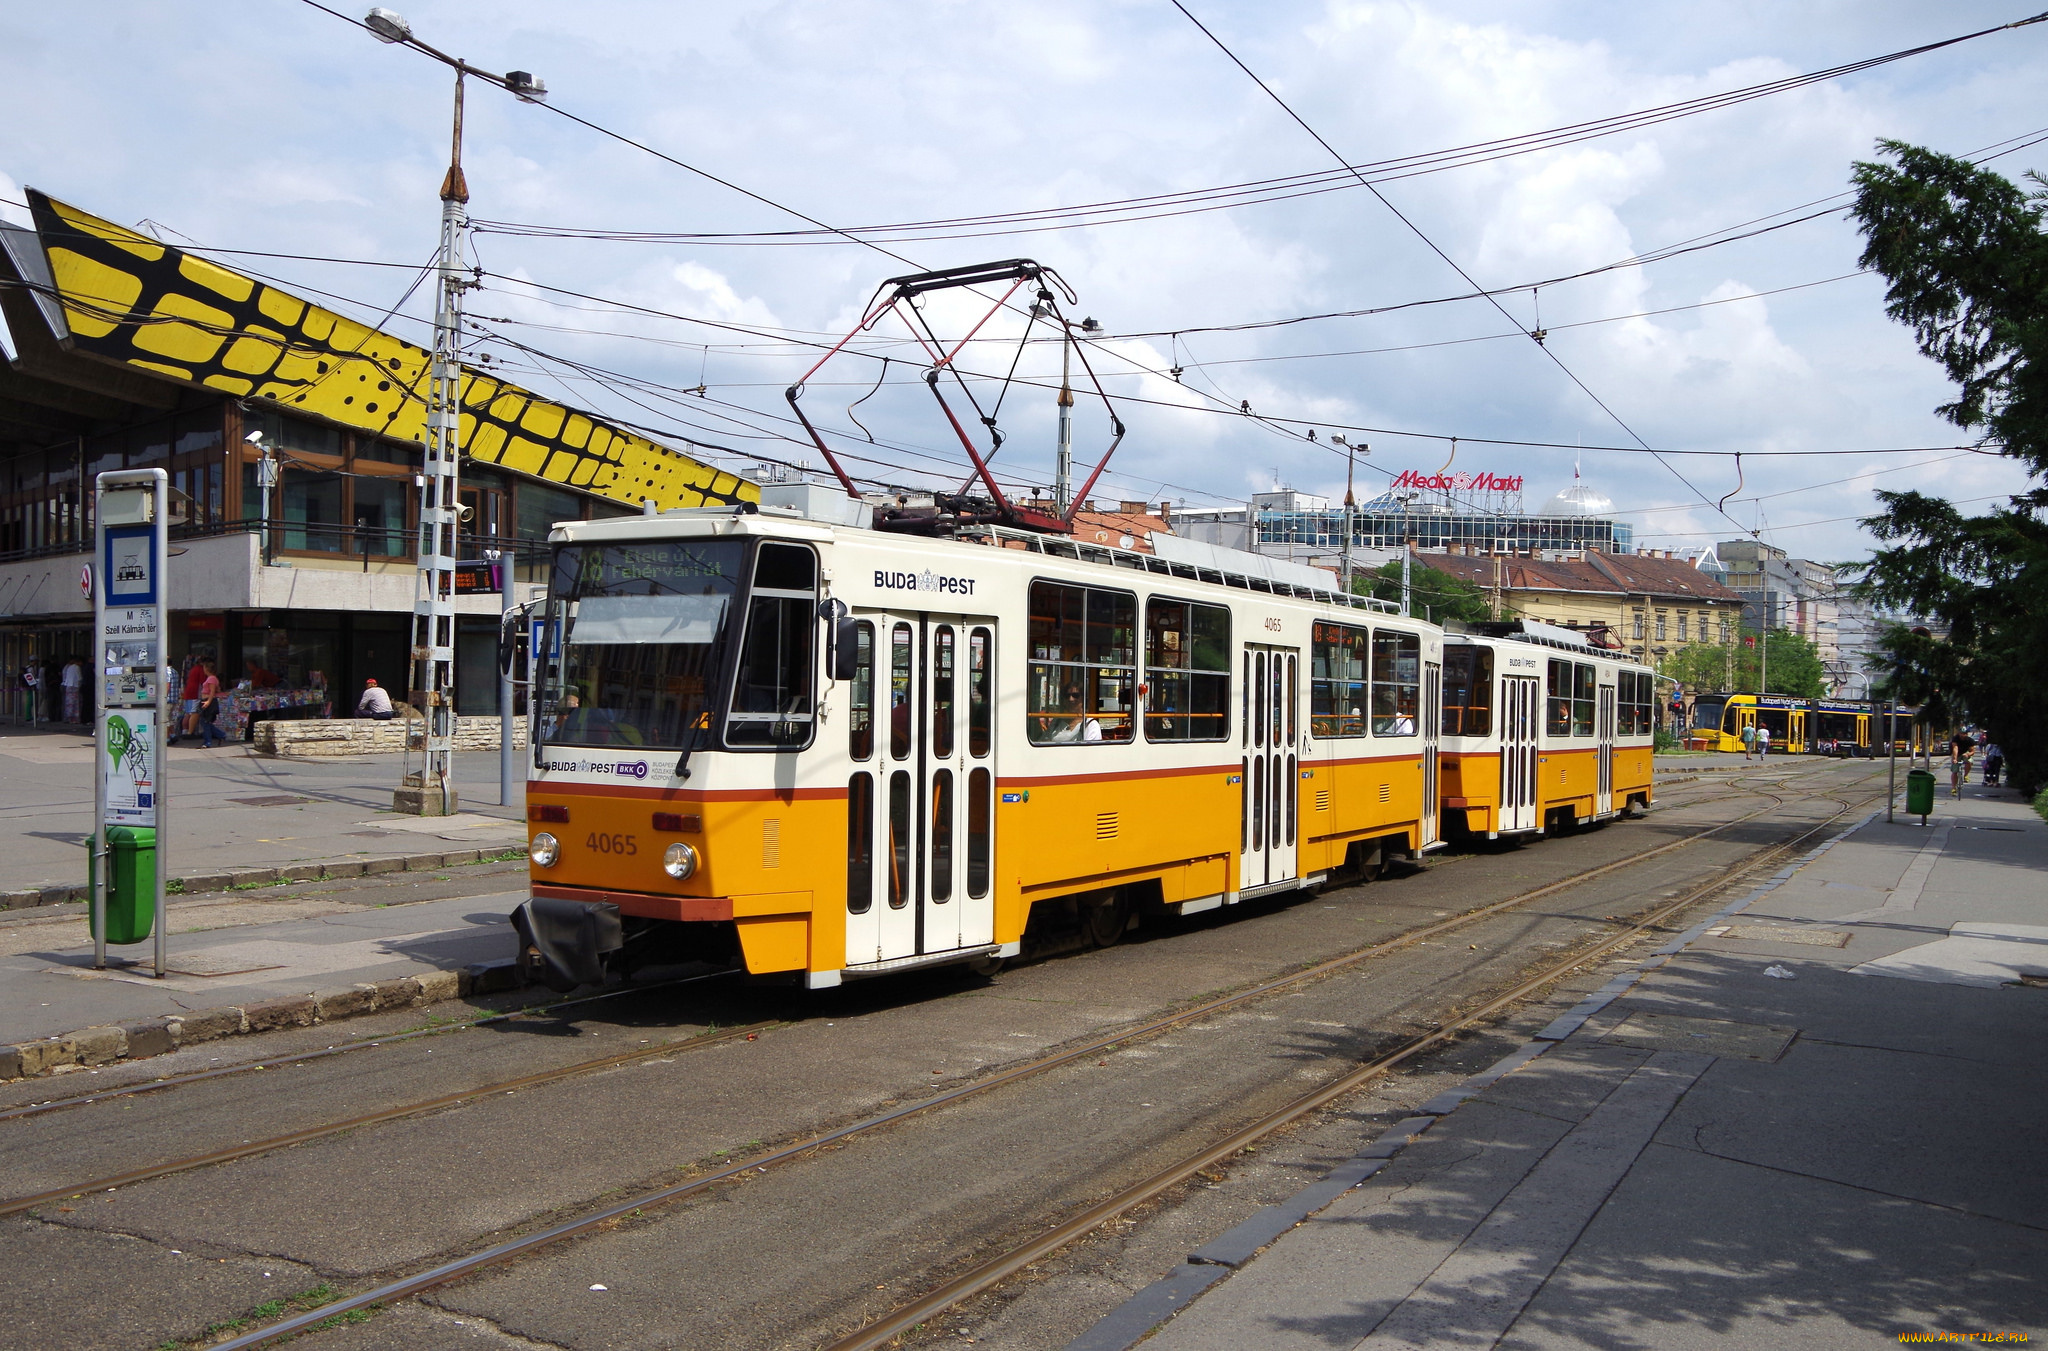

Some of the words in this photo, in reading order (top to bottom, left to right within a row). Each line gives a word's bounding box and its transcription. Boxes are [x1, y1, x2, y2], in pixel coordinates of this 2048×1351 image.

[1391, 470, 1453, 489] Media
[1468, 472, 1523, 491] Markt
[127, 611, 134, 621] M
[105, 624, 120, 635] Széll
[122, 623, 146, 635] Kálmán
[1264, 617, 1282, 632] 4065
[619, 764, 634, 773] BKK
[586, 832, 638, 856] 4065
